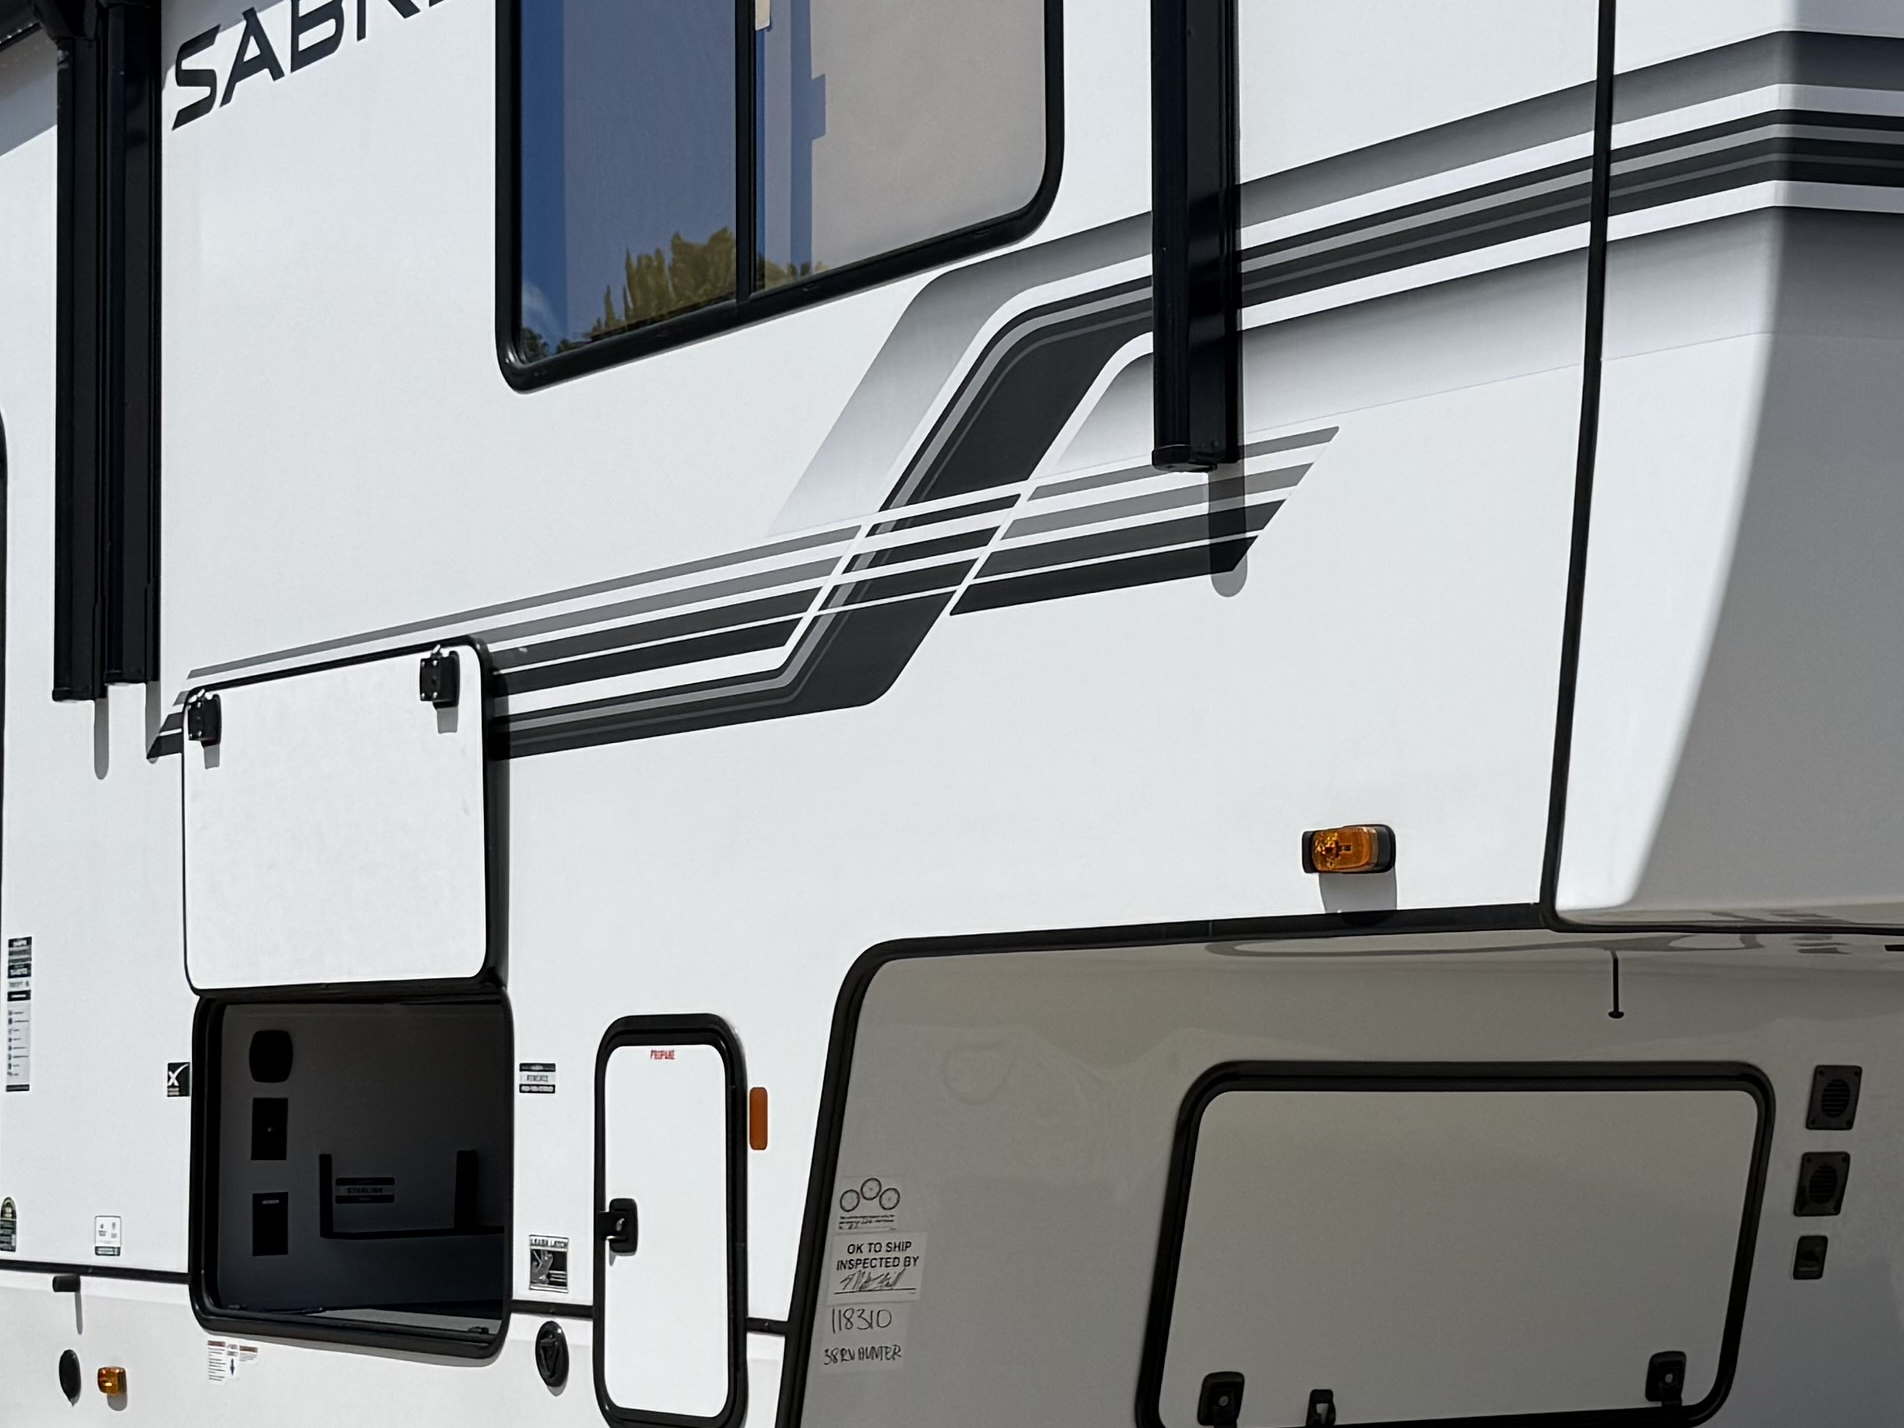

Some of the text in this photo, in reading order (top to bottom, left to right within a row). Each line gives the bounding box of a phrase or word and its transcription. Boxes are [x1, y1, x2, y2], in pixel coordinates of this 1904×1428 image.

[847, 1240, 912, 1254] OK TO SHIP
[836, 1255, 919, 1271] INSPECTED BY
[831, 1307, 892, 1334] 118310
